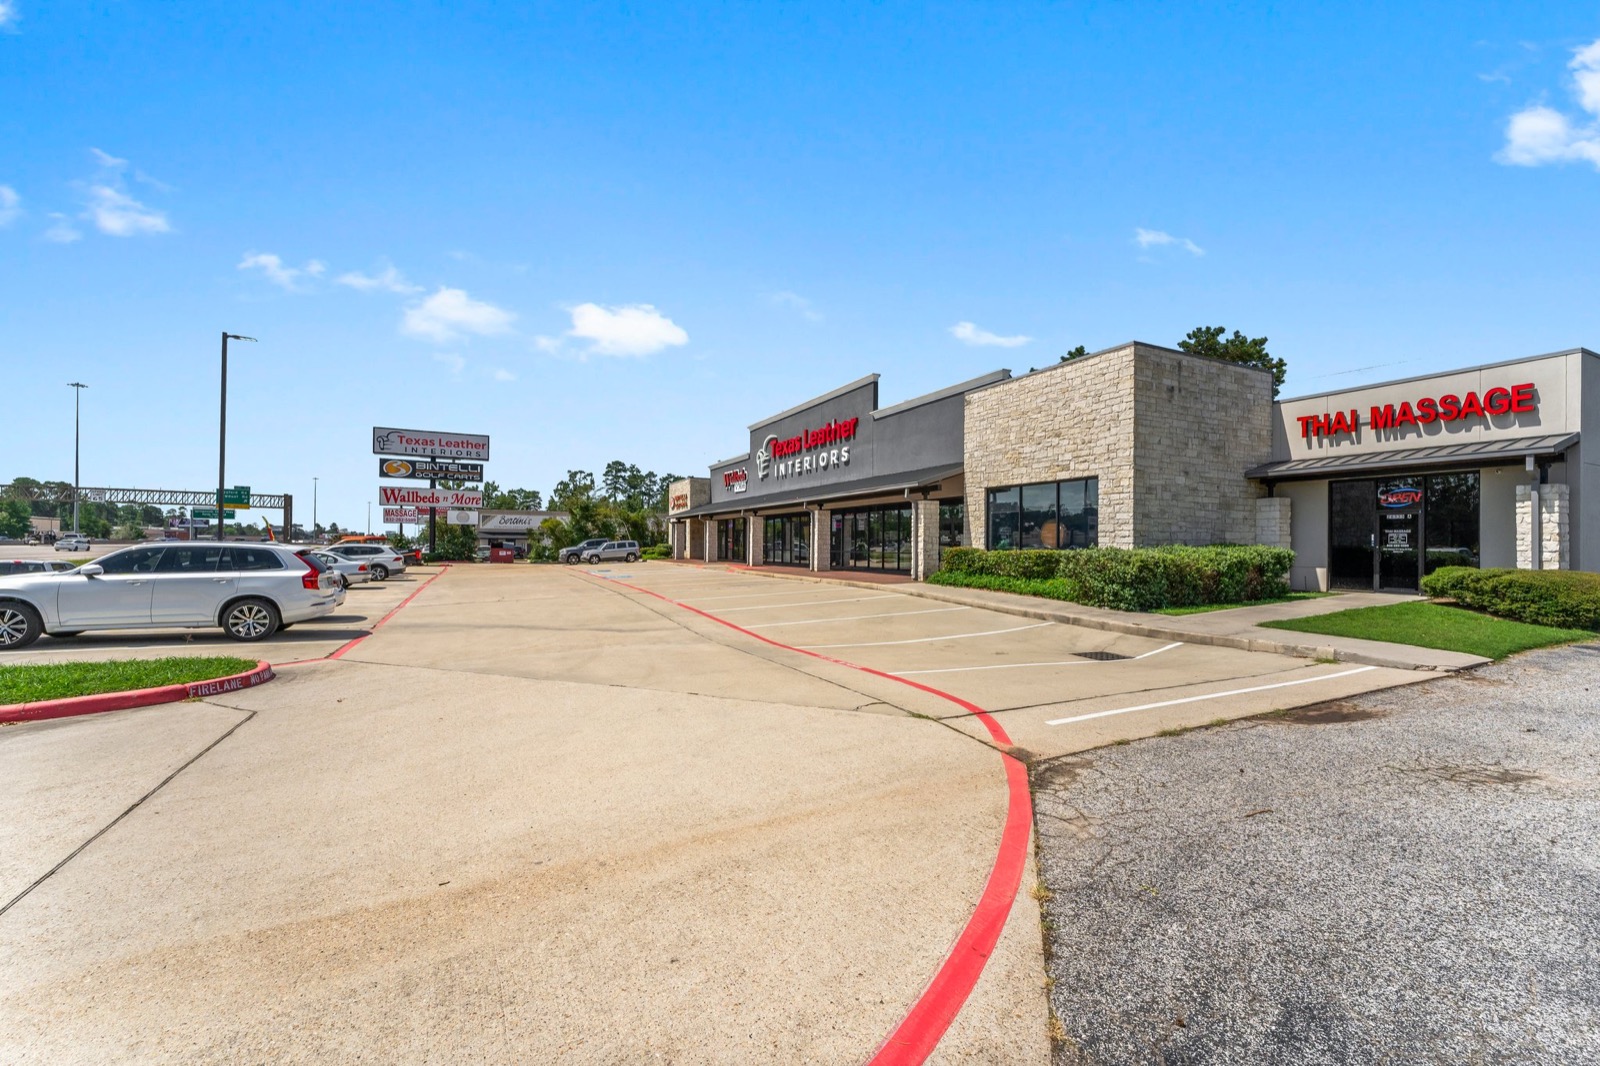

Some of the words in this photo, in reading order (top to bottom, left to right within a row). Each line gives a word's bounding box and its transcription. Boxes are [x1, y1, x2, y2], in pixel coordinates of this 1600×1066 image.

[1297, 409, 1358, 438] THAI
[1370, 383, 1536, 430] MASSAGE
[397, 434, 435, 447] Texas
[438, 438, 487, 450] Leather
[770, 435, 802, 458] Texas
[803, 417, 858, 449] Leather
[404, 447, 481, 457] INTERIORS
[415, 462, 481, 473] BINTELLI
[774, 446, 850, 477] INTERIORS
[415, 472, 445, 480] GOLF
[382, 488, 440, 505] Wallbeds
[450, 493, 482, 506] More
[1380, 491, 1424, 505] OPEN
[384, 508, 417, 518] MASSAGE
